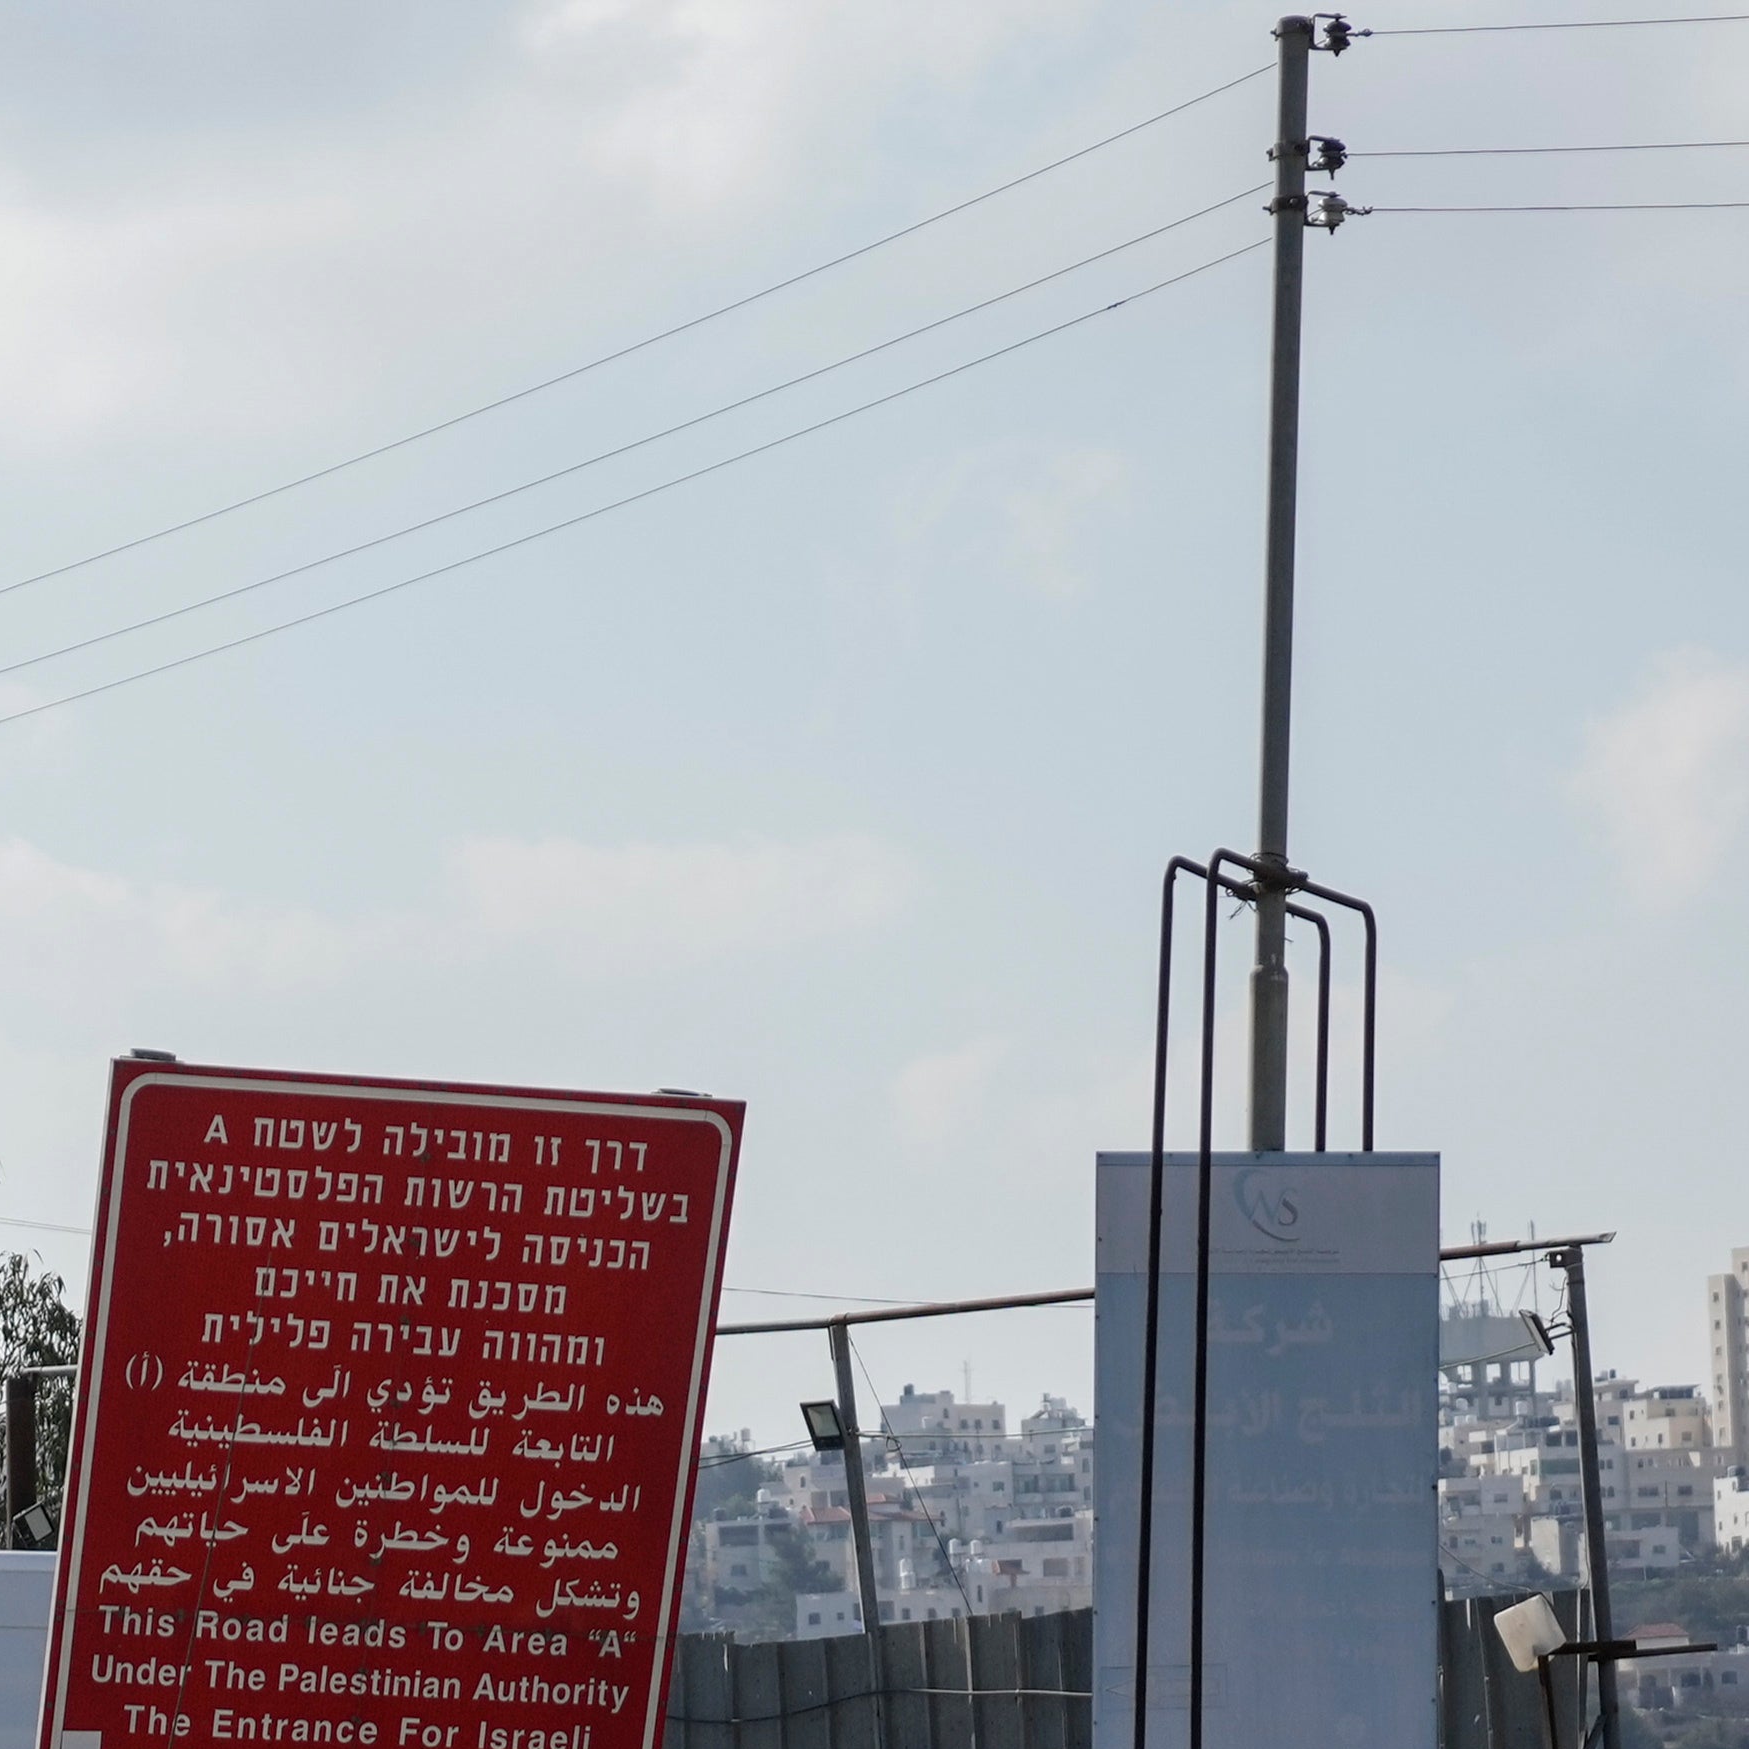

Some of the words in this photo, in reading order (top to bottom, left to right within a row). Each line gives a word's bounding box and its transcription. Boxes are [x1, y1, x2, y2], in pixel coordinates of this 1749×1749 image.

[204, 1114, 229, 1144] A
[253, 1115, 362, 1153] לשטח
[382, 1122, 512, 1163] מובילה
[534, 1136, 562, 1166] זו
[585, 1137, 649, 1173] דרך
[147, 1159, 385, 1205] הפלסטינאית
[403, 1176, 523, 1213] הרשות
[543, 1184, 690, 1224] בשליטת
[163, 1211, 296, 1249] אסורה,
[318, 1219, 502, 1260] לישראלים
[521, 1234, 651, 1271] הכניסה
[254, 1266, 357, 1302] חייכם
[377, 1273, 427, 1306] את
[449, 1279, 567, 1314] מסכנת
[202, 1312, 330, 1350] פלילית
[349, 1320, 461, 1358] עבירה
[482, 1330, 605, 1367] ומהווה
[178, 1360, 287, 1394] منطقة
[366, 1375, 453, 1416] تؤدي
[468, 1383, 585, 1420] الطريق
[605, 1386, 665, 1418] هذه
[169, 1410, 348, 1450] الفلسطينية
[369, 1422, 490, 1456] للسلطة
[512, 1428, 614, 1469] التابعة
[335, 1470, 499, 1514] للمواطنين
[519, 1480, 641, 1521] الدخول
[135, 1511, 249, 1549] حياتهم
[353, 1520, 471, 1565] وخطرة
[493, 1525, 620, 1570] ممنوعة
[98, 1556, 193, 1597] حقهم
[211, 1560, 255, 1604] في
[277, 1564, 376, 1603] جنائية
[398, 1570, 515, 1606] مخالفة
[534, 1579, 641, 1622] وتشكل
[98, 1604, 176, 1638] This
[196, 1610, 288, 1643] Road
[307, 1616, 407, 1649] leads
[428, 1622, 464, 1652] To
[482, 1625, 568, 1656] Area
[91, 1654, 192, 1687] Under
[204, 1659, 266, 1692] The
[278, 1663, 462, 1701] Palestinian
[473, 1672, 630, 1714] Authority
[123, 1704, 192, 1737] The
[211, 1709, 380, 1746] Entrance
[398, 1717, 460, 1749] For
